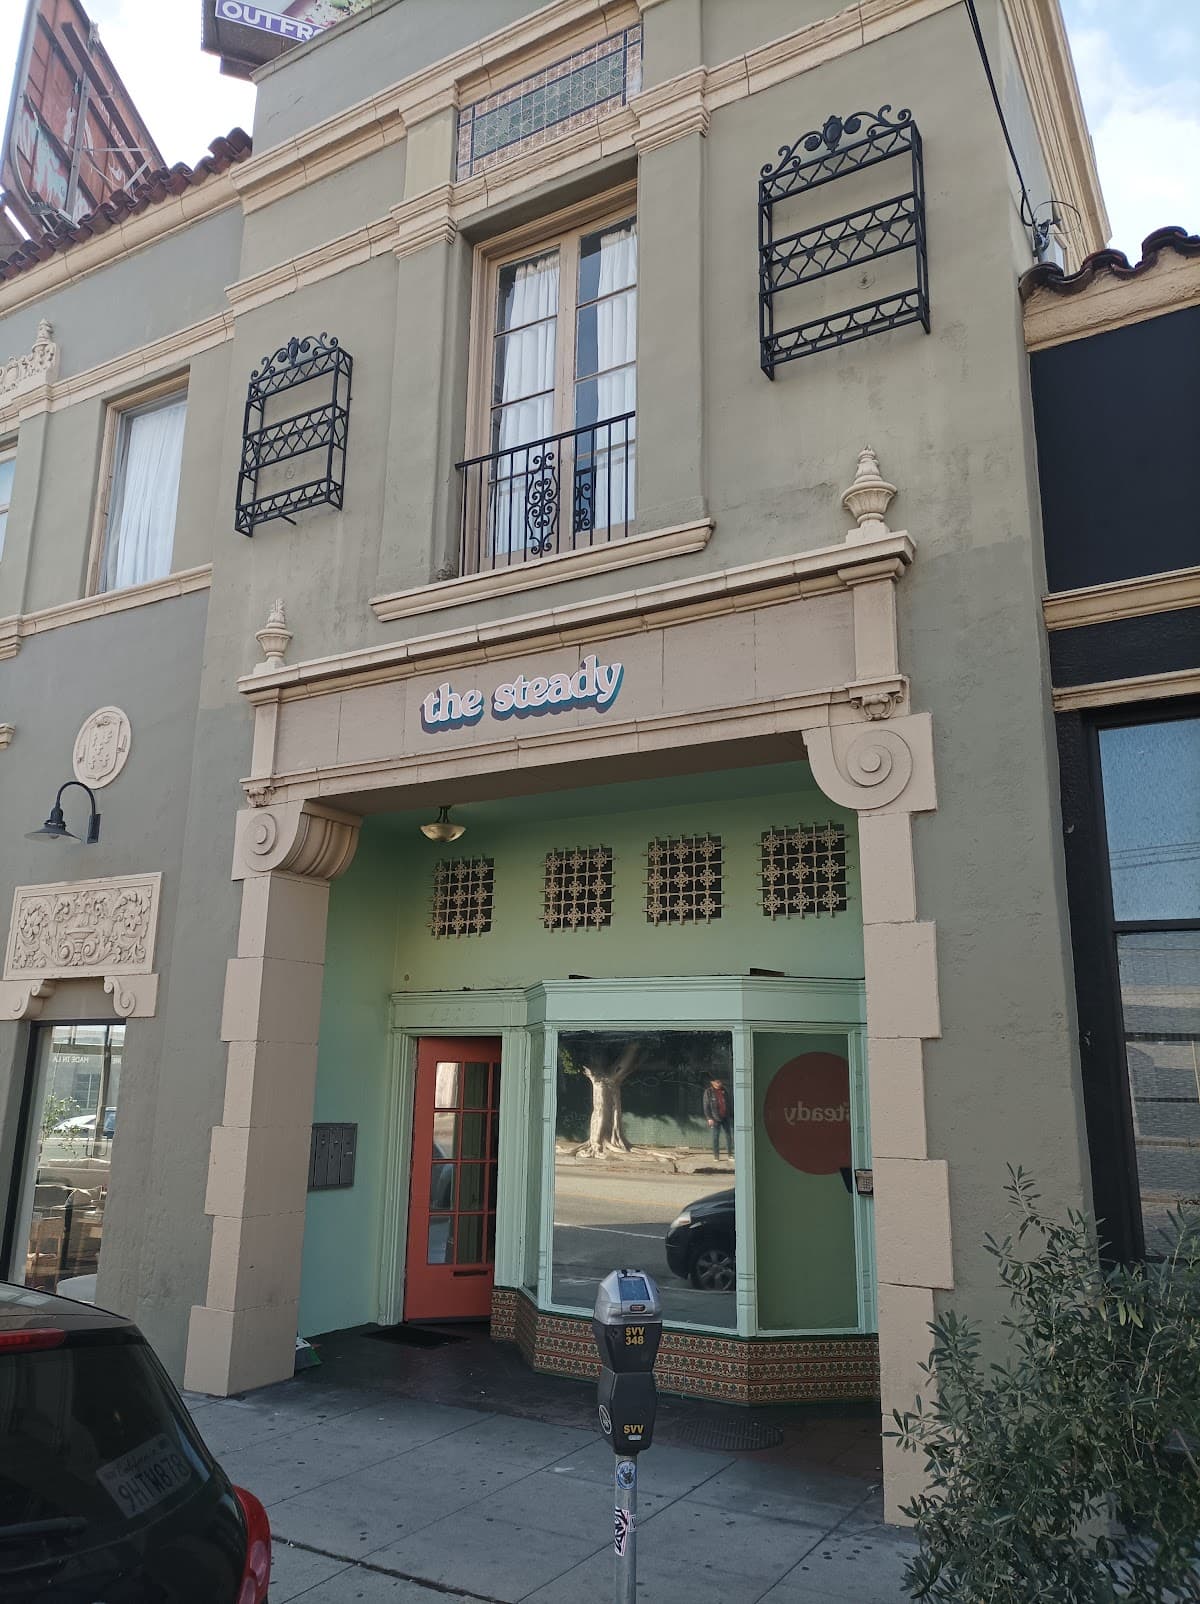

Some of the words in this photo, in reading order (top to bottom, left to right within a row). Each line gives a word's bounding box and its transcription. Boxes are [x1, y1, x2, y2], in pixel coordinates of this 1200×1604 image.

[422, 682, 484, 732] the
[492, 654, 624, 719] steady
[625, 1336, 644, 1346] 348
